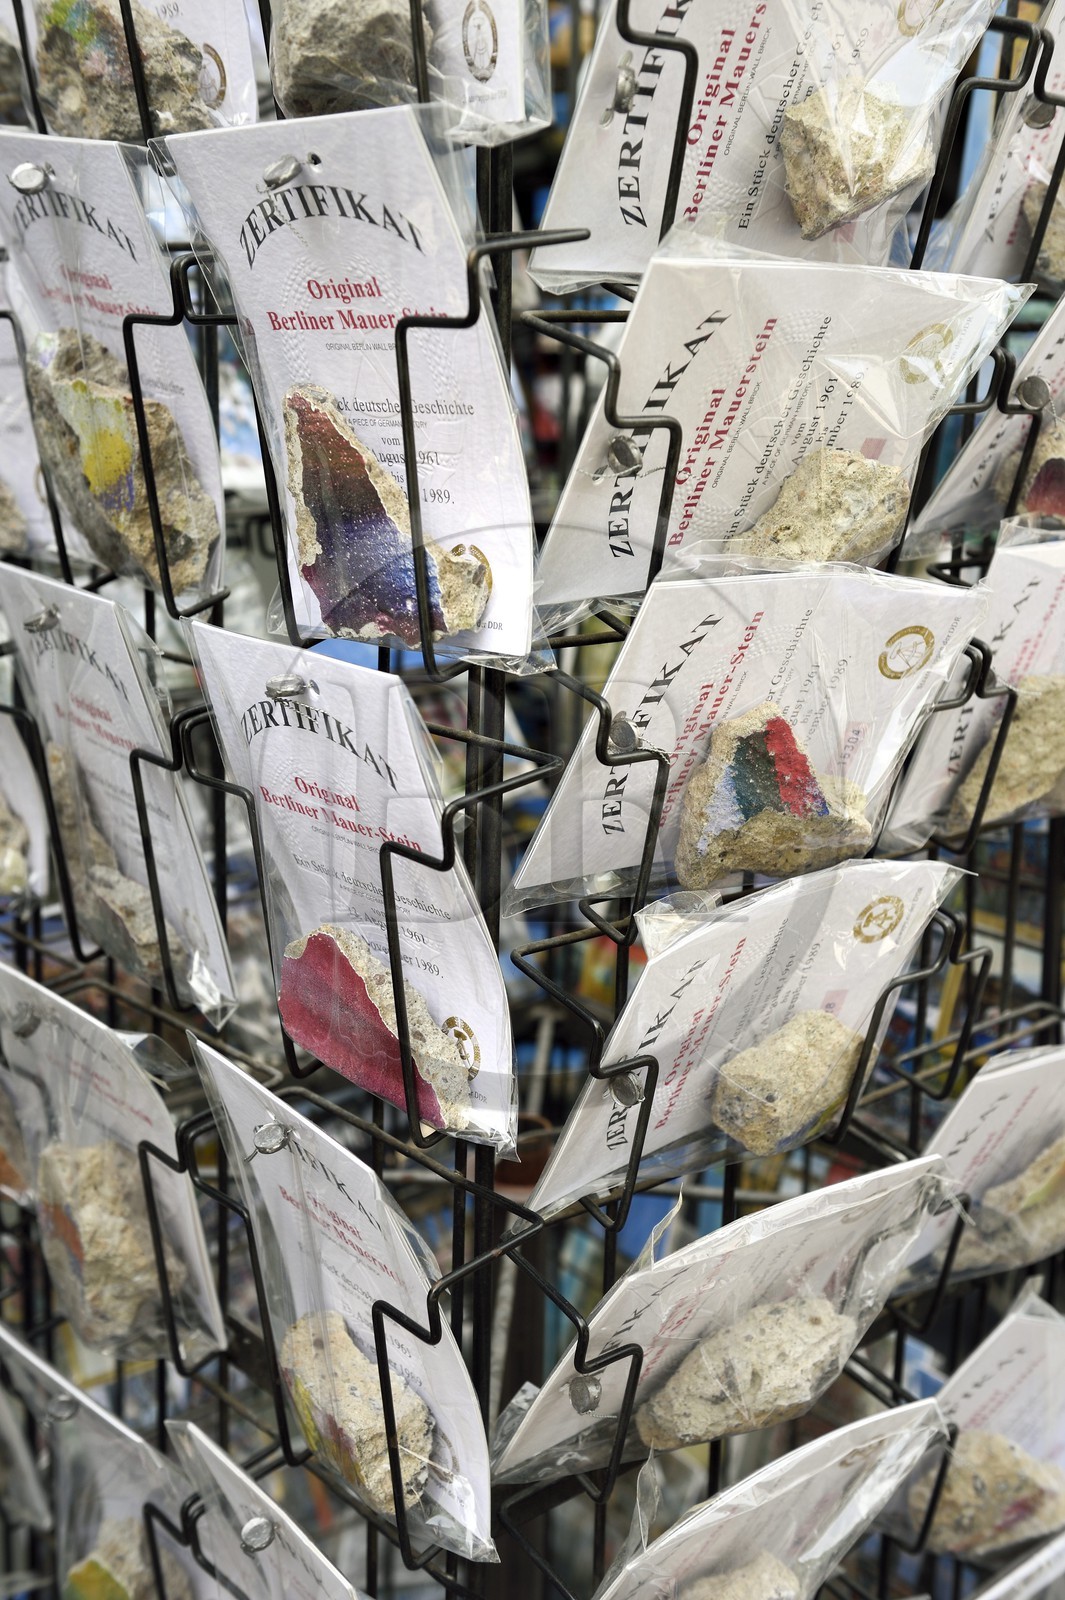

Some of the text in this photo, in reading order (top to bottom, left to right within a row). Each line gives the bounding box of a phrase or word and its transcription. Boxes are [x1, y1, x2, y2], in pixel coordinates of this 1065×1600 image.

[686, 29, 736, 145] Original
[723, 114, 743, 157] ORIGINAL
[748, 55, 762, 79] WALL
[757, 26, 772, 55] BRICK
[738, 201, 755, 230] Ein
[747, 149, 770, 197] Stück
[765, 60, 801, 145] deutscher
[683, 116, 728, 222] Berliner
[239, 185, 427, 271] ZERTIFIKAT
[307, 276, 383, 304] Original
[267, 310, 335, 332] Berliner
[325, 342, 352, 351] ORIGINAL
[352, 342, 373, 351] BERLIN
[373, 342, 389, 351] WALL
[352, 396, 401, 414] deutsche
[734, 477, 760, 518] Stück
[753, 402, 792, 475] deutscher
[787, 315, 832, 403] Geschichte
[791, 377, 839, 466] August 1961
[381, 436, 401, 446] vom
[667, 317, 778, 548] Berliner Mauerstein
[674, 388, 726, 486] Original
[790, 420, 807, 447] vom
[815, 425, 830, 443] bis
[418, 450, 440, 465] 961
[711, 450, 731, 489] ORIGINAL
[422, 488, 455, 505] 1989.
[487, 621, 503, 631] DDR
[769, 608, 813, 687] Geschichte
[692, 610, 765, 743] Mauer-Stein
[826, 651, 852, 691] 1989.
[601, 613, 725, 836] ZERFIKAT
[240, 698, 400, 796] ZERTIFIKAT
[260, 785, 319, 821] Berliner
[294, 776, 361, 813] Original
[341, 870, 384, 897] deutsche
[415, 957, 445, 979] 1989.
[689, 936, 747, 1056] Mauer-Stein
[664, 1006, 706, 1087] Original
